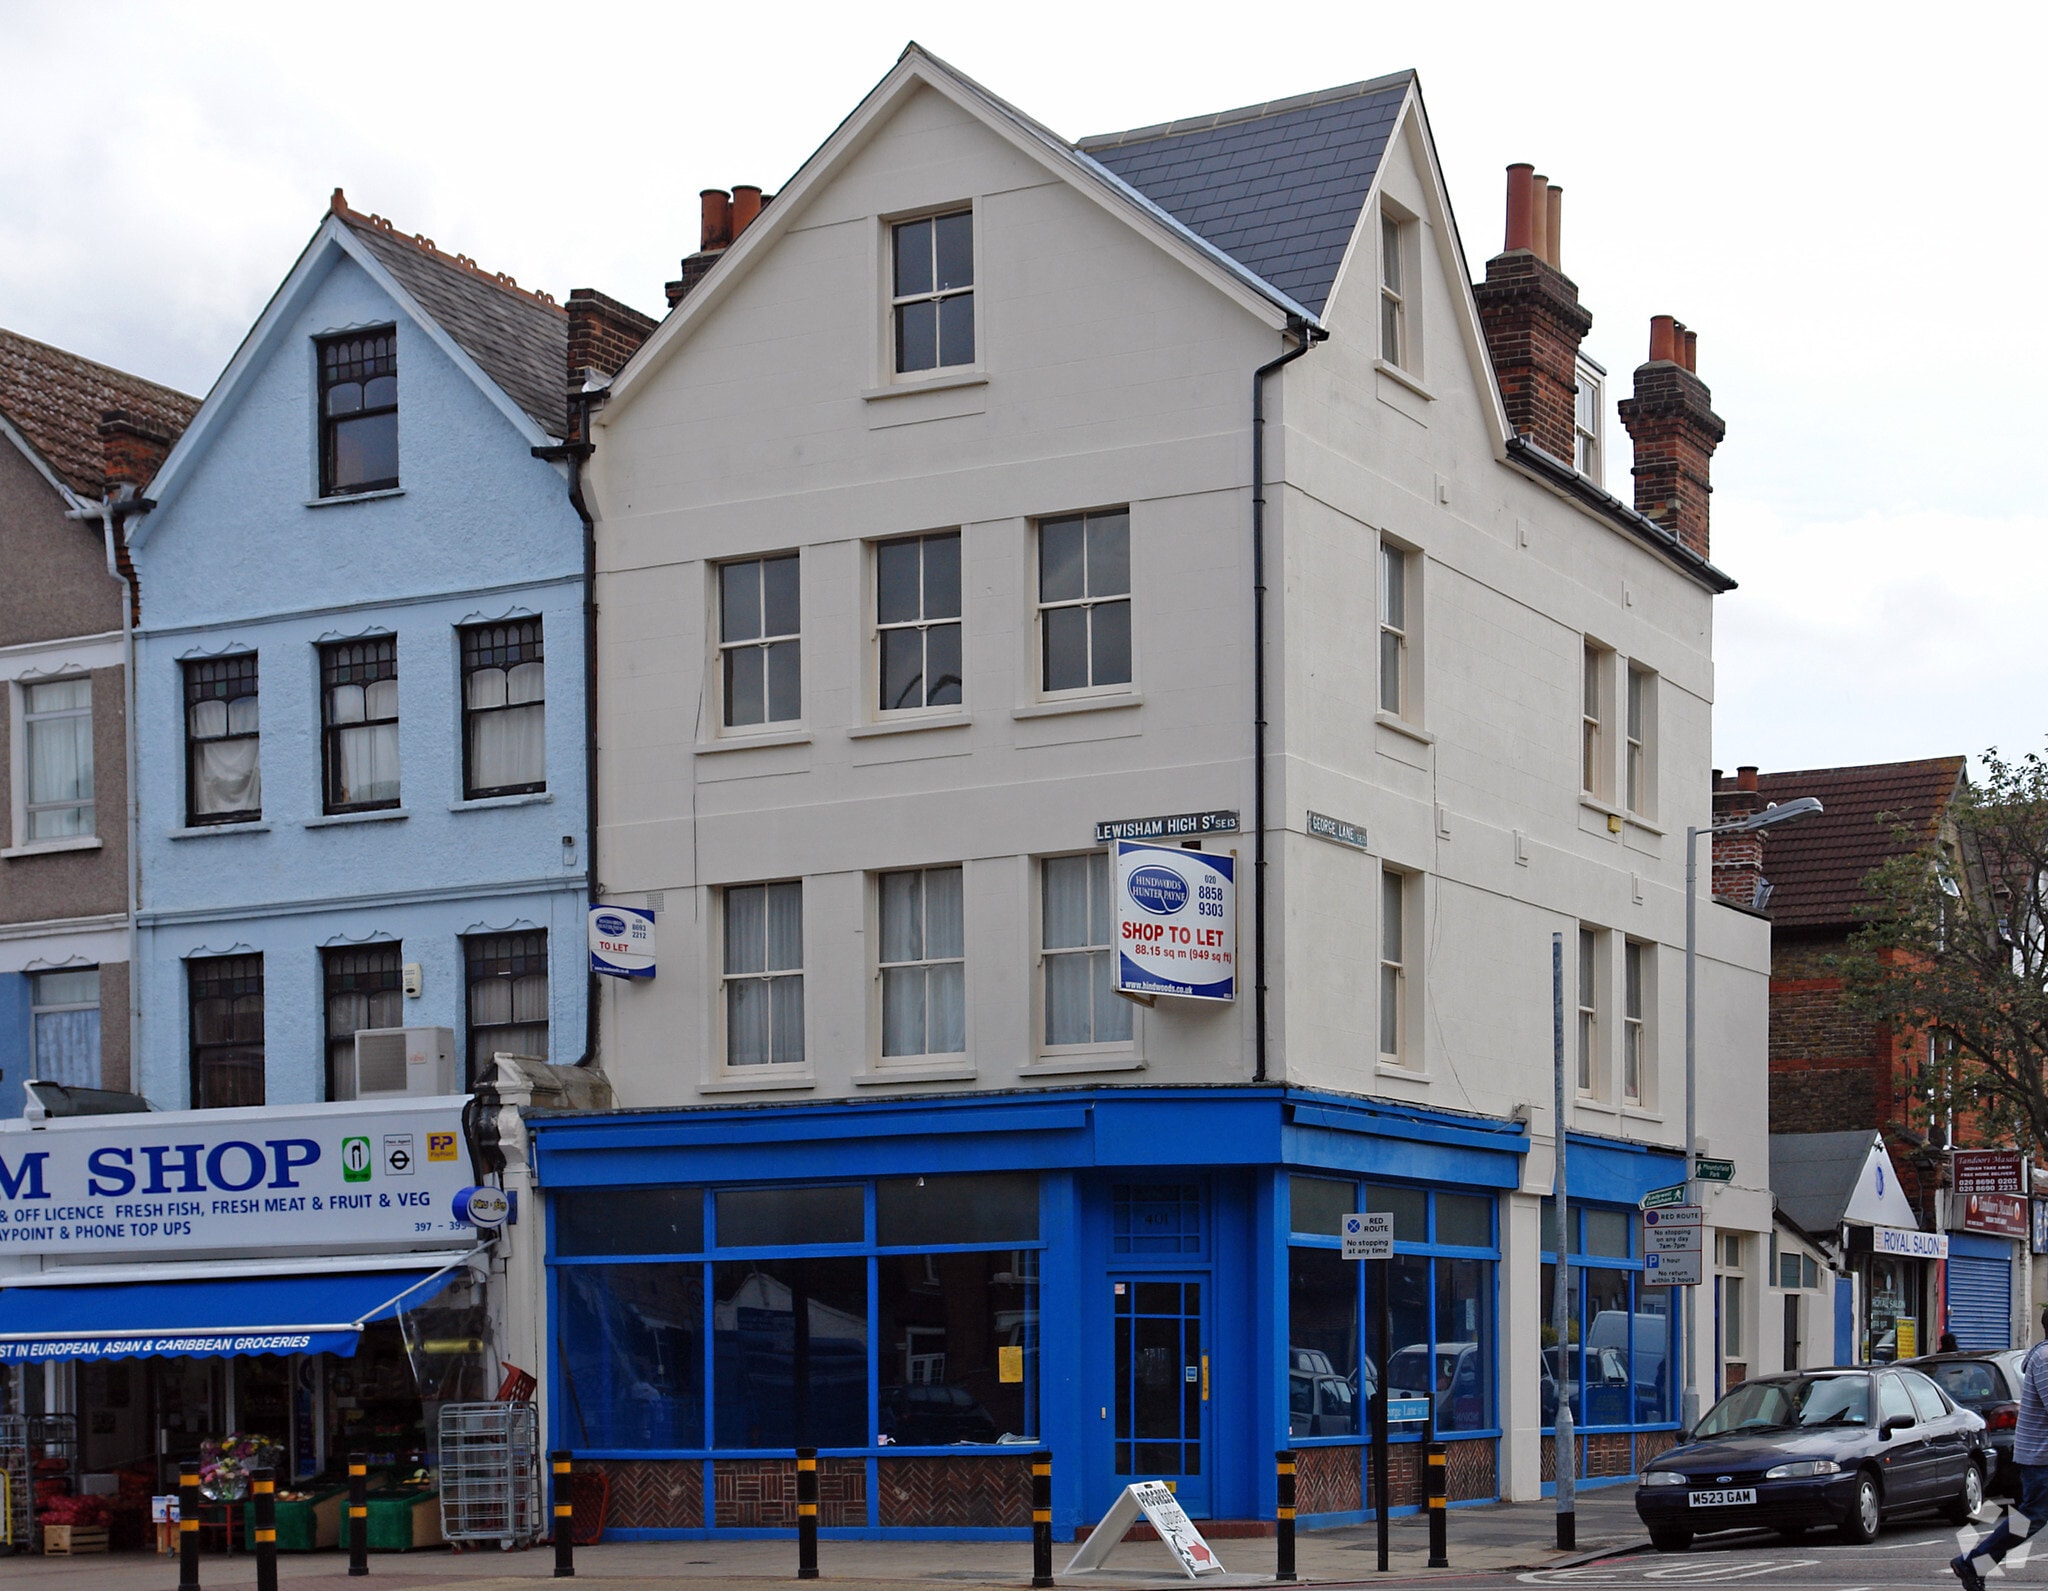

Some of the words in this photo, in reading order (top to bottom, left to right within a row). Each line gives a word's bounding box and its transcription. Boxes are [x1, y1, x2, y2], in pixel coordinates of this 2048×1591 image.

[1096, 820, 1162, 839] LEWISHAM
[1168, 817, 1197, 832] HIGH
[1216, 818, 1236, 828] SE13
[1312, 815, 1335, 835] GEORGE
[1339, 823, 1354, 840] LANE
[1135, 875, 1181, 891] HINDWOODS
[1204, 875, 1217, 884] 020
[1132, 886, 1162, 898] HUNTER
[1163, 889, 1186, 902] PAYNE
[1198, 886, 1223, 901] 8858
[1198, 902, 1223, 917] 9303
[632, 931, 647, 939] 2212
[1122, 921, 1164, 942] SHOP
[1169, 926, 1191, 944] TO
[1196, 928, 1224, 947] LET
[600, 941, 611, 950] TO
[613, 943, 629, 952] LET
[1135, 944, 1161, 956] 88.15
[1163, 948, 1174, 959] sq
[1177, 950, 1186, 958] m
[1189, 948, 1209, 961] (949
[1211, 953, 1221, 963] sq
[1223, 952, 1232, 964] ft)
[1125, 981, 1193, 994] www.hindwoods.co.uk
[88, 1138, 321, 1197] SHOP
[1957, 1156, 1991, 1164] Tandoori
[115, 1203, 163, 1218] FRESH
[168, 1202, 205, 1217] FISH,
[212, 1199, 259, 1214] FRESH
[264, 1197, 306, 1212] MEAT
[312, 1196, 323, 1210] &
[330, 1194, 372, 1209] FRUIT
[379, 1193, 390, 1207] &
[398, 1192, 430, 1207] VEG
[0, 1209, 9, 1223] &
[14, 1208, 40, 1222] OFF
[45, 1205, 104, 1221] LICENCE
[60, 1226, 70, 1239] &
[76, 1224, 124, 1238] PHONE
[130, 1222, 158, 1236] TOP
[163, 1221, 191, 1235] UPS
[414, 1222, 432, 1231] 397
[1665, 1229, 1691, 1237] stopping
[1883, 1231, 1910, 1253] ROYAL
[1913, 1235, 1940, 1256] SALON
[1649, 1256, 1657, 1267] P
[16, 1344, 28, 1357] IN
[30, 1342, 100, 1356] EUROPEAN,
[102, 1340, 142, 1354] ASIAN
[142, 1340, 153, 1351] &
[155, 1338, 233, 1351] CARIBBEAN
[234, 1336, 311, 1350] GROCERIES
[1727, 1490, 1751, 1503] GAM
